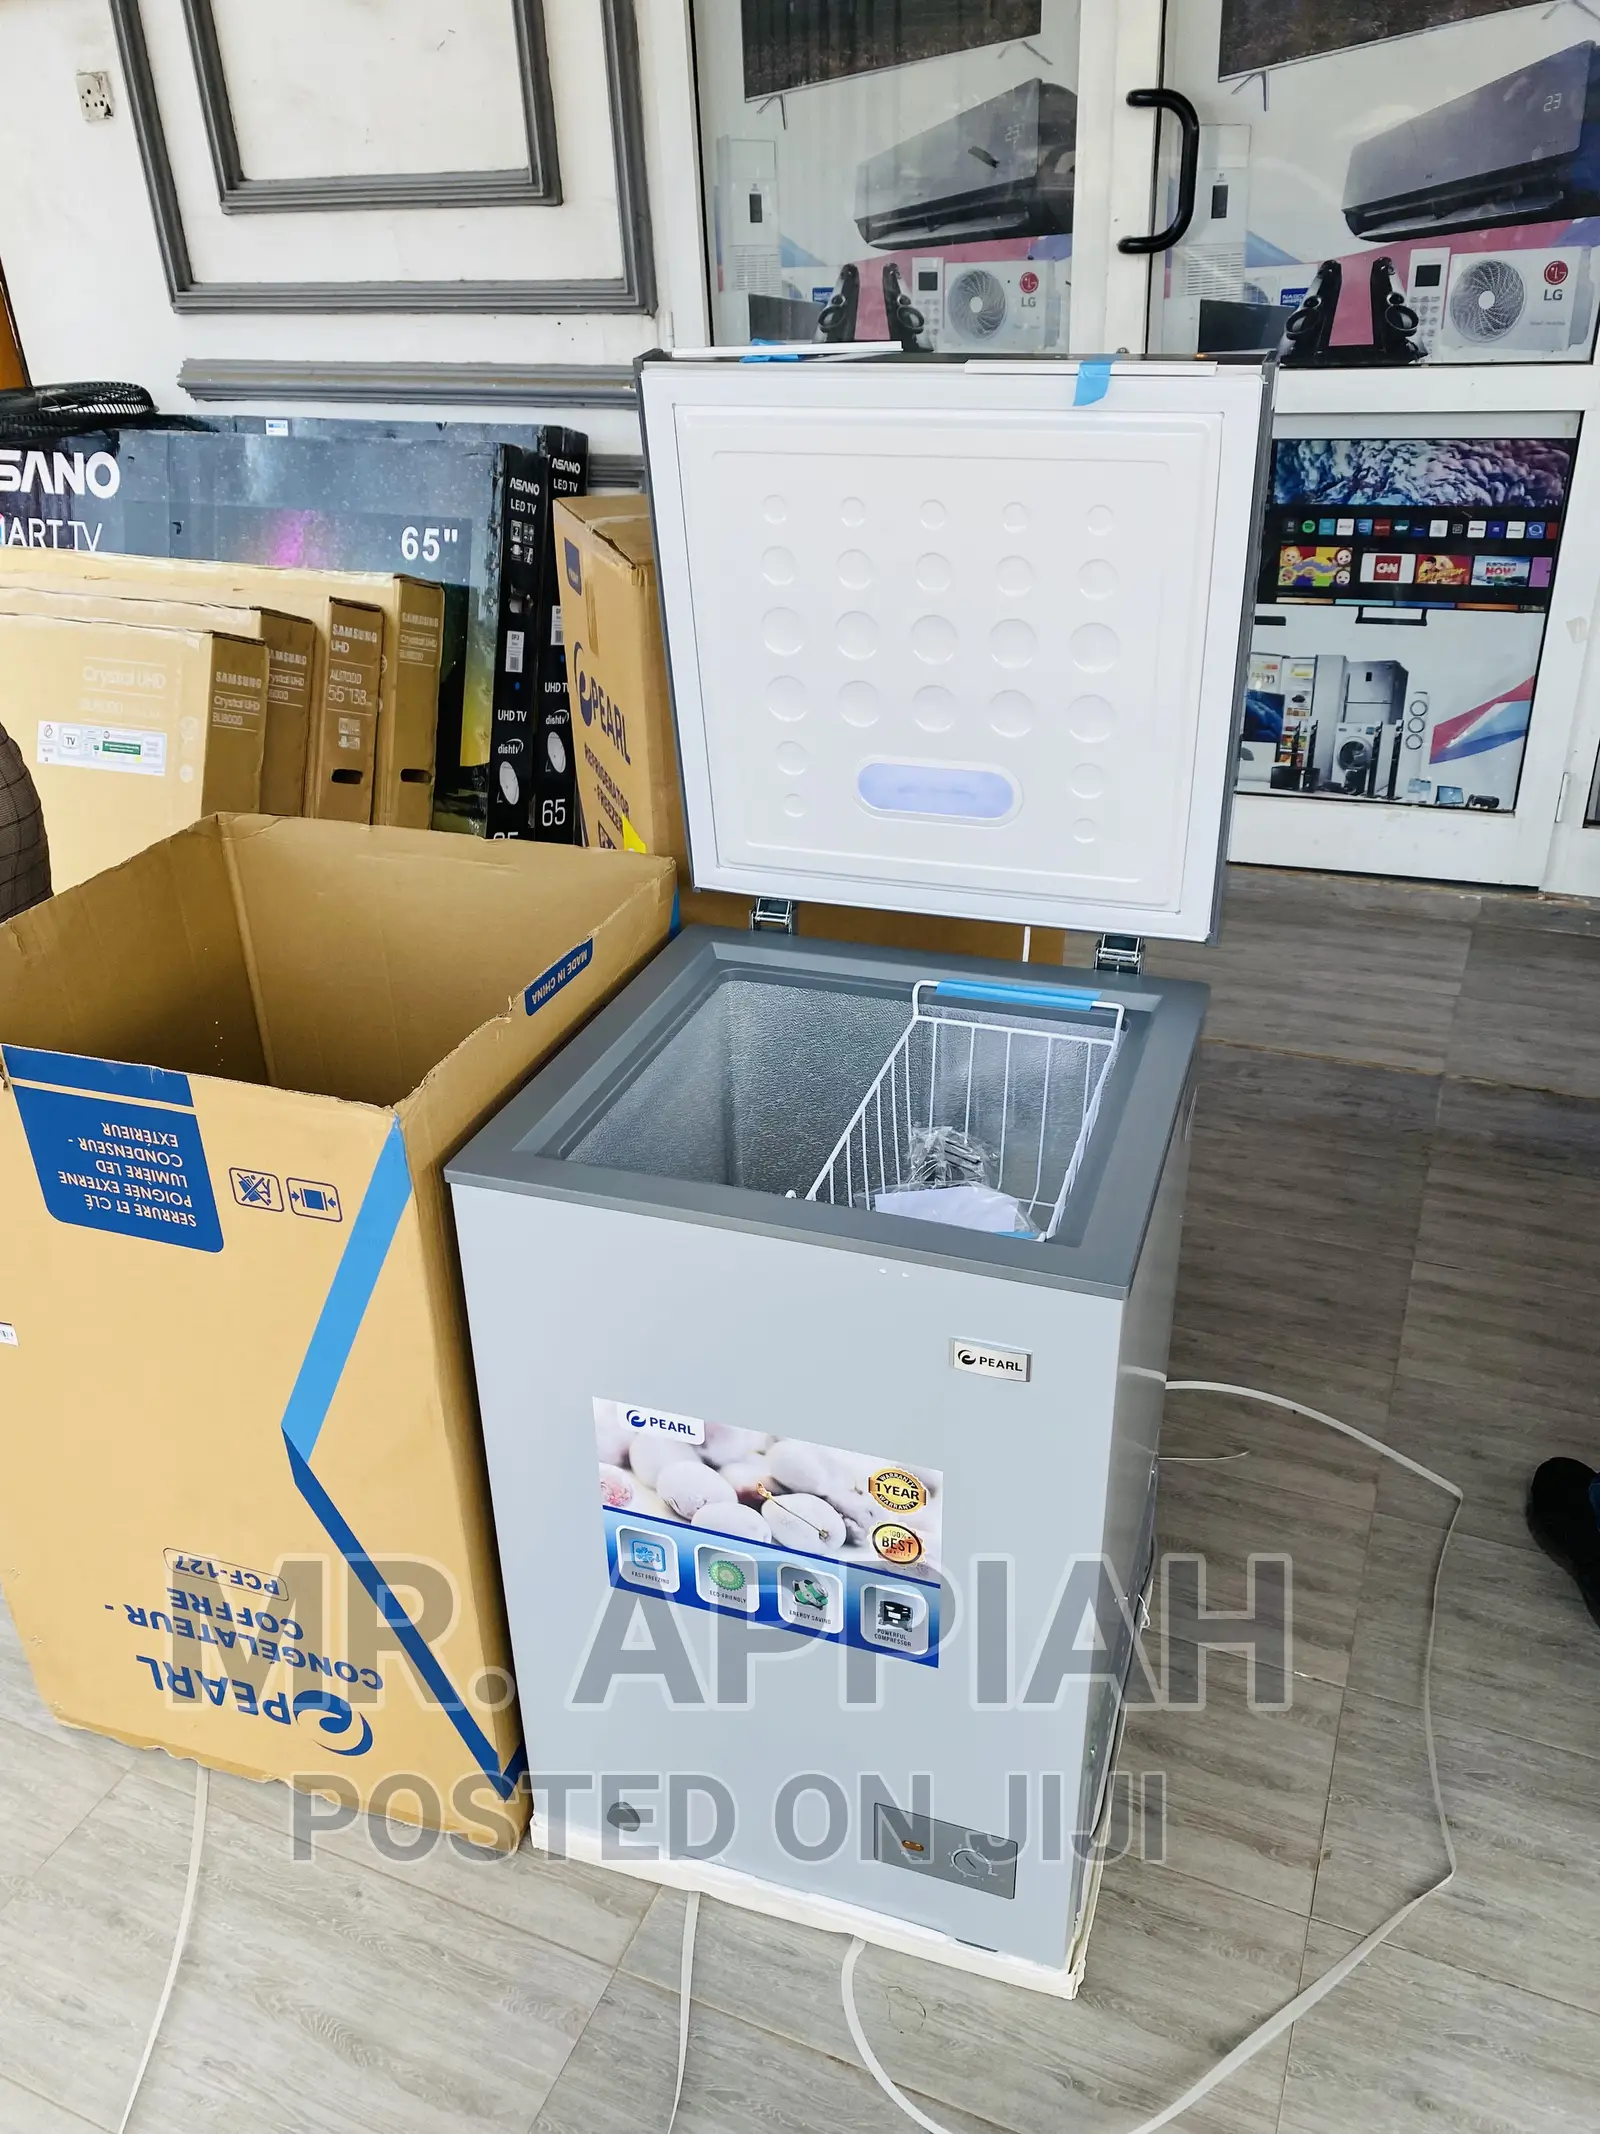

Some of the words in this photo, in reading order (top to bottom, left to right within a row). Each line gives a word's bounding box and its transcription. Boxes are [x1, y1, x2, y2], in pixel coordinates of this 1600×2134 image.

[1543, 92, 1562, 113] 23
[1021, 297, 1036, 308] LG
[1543, 288, 1563, 301] LG
[552, 458, 581, 475] ASANO
[509, 477, 540, 496] ASANO
[553, 478, 567, 491] LED
[568, 482, 579, 493] TV
[510, 498, 526, 512] LED
[526, 502, 537, 515] TV
[67, 520, 103, 551] TV
[401, 526, 458, 562] 65"
[1376, 562, 1399, 574] CNN
[332, 624, 378, 643] SAMSUNG
[331, 640, 350, 653] UHD
[269, 649, 307, 665] AMSUNG
[83, 666, 135, 686] Crystal
[136, 671, 166, 690] UHD
[215, 671, 262, 689] SAMSUNG
[544, 682, 560, 693] UHD
[213, 695, 244, 708] Crystal
[497, 709, 515, 721] UHD
[516, 710, 527, 722] TV
[545, 709, 570, 725] dishtv
[590, 676, 631, 766] PEARL
[65, 736, 76, 745] TV
[497, 739, 524, 754] dishtv
[542, 799, 566, 827] 65
[567, 949, 588, 975] MADE
[557, 967, 566, 984] IN
[531, 976, 556, 1005] CHINA
[101, 1122, 179, 1147] EXTÉRIEUR
[77, 1137, 183, 1168] CONDENSEUR
[95, 1159, 122, 1176] LED
[125, 1164, 188, 1188] LUMIÈRE
[58, 1170, 120, 1194] EXTERNE
[83, 1194, 112, 1211] CLÉ
[123, 1183, 193, 1208] POIGNÉE
[116, 1200, 131, 1215] ET
[134, 1203, 197, 1228] SERRURE
[979, 1356, 1023, 1372] PEARL
[649, 1416, 696, 1436] PEARL
[880, 1472, 916, 1489] WARRANTY
[875, 1482, 881, 1492] 1
[883, 1483, 920, 1500] YEAR
[879, 1495, 916, 1510] WARRANTY
[881, 1536, 914, 1554] BEST
[175, 1555, 280, 1596] PCF-127
[631, 1570, 645, 1578] FAST
[166, 1587, 304, 1640] COFFRE
[789, 1609, 811, 1620] ENERGY
[874, 1633, 912, 1647] COMPRESSOR
[877, 1628, 907, 1640] POWERFUL
[123, 1603, 384, 1690] CONGÉLATEUR
[136, 1654, 292, 1726] PEARL
